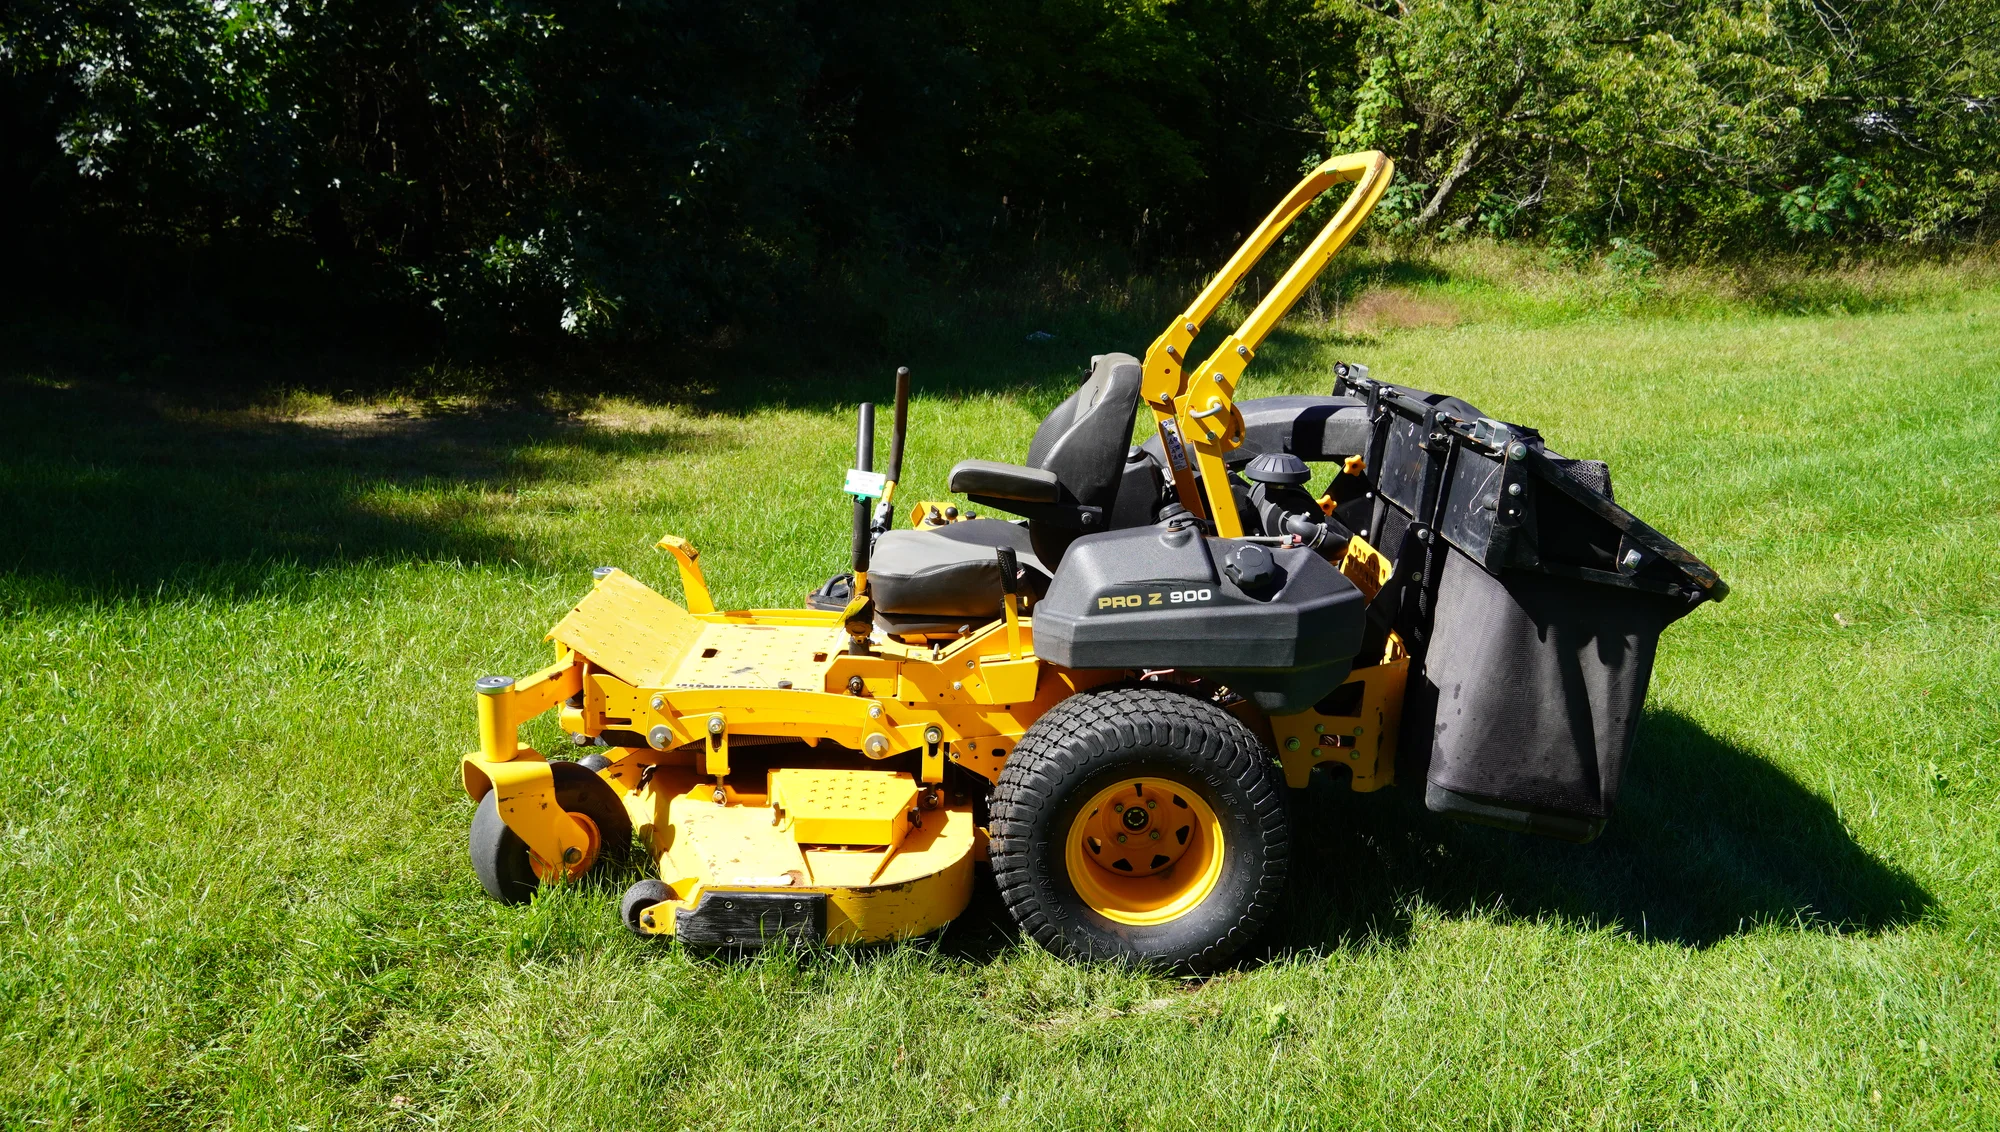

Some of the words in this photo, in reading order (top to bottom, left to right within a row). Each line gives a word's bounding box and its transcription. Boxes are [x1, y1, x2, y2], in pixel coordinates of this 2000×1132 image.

[1097, 594, 1142, 610] PRO
[1148, 593, 1163, 606] Z
[1169, 589, 1212, 604] 900
[1187, 763, 1250, 825] TURF
